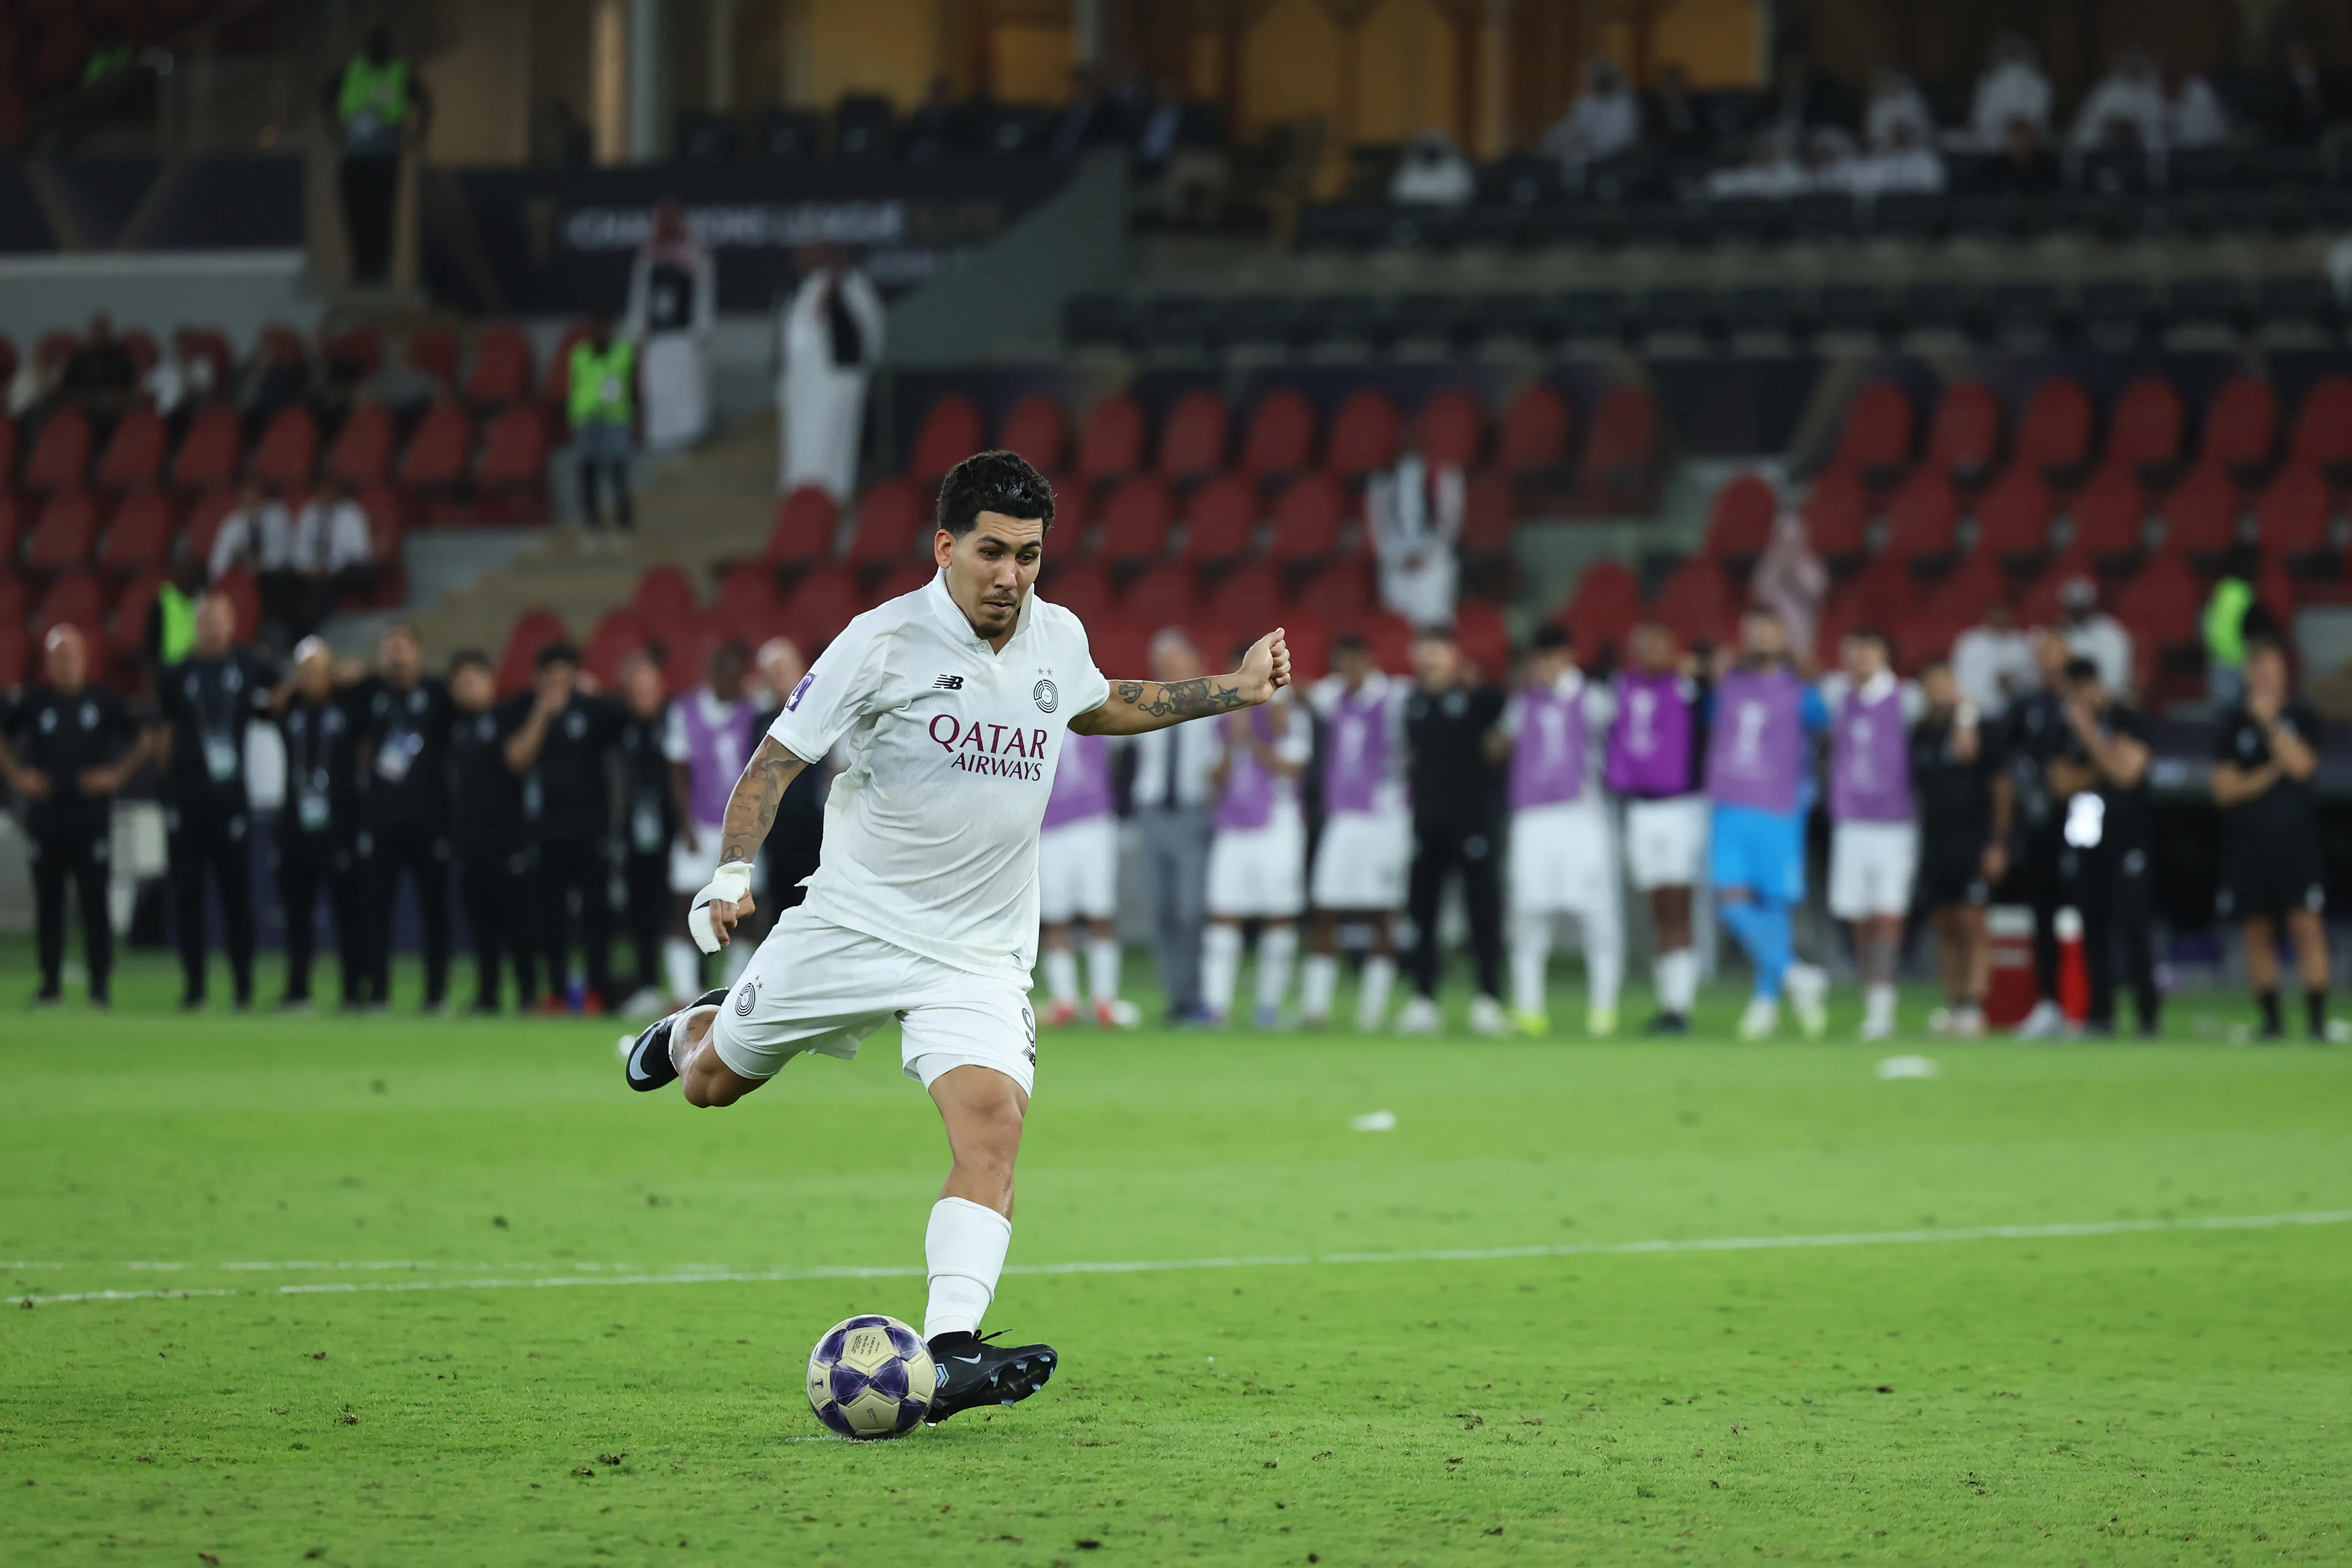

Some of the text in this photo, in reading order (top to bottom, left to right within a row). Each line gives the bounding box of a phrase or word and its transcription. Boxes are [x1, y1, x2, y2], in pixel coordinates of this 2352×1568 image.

[929, 714, 1047, 759] QATAR
[951, 752, 1042, 781] AIRWAYS
[1022, 1007, 1035, 1048] 9
